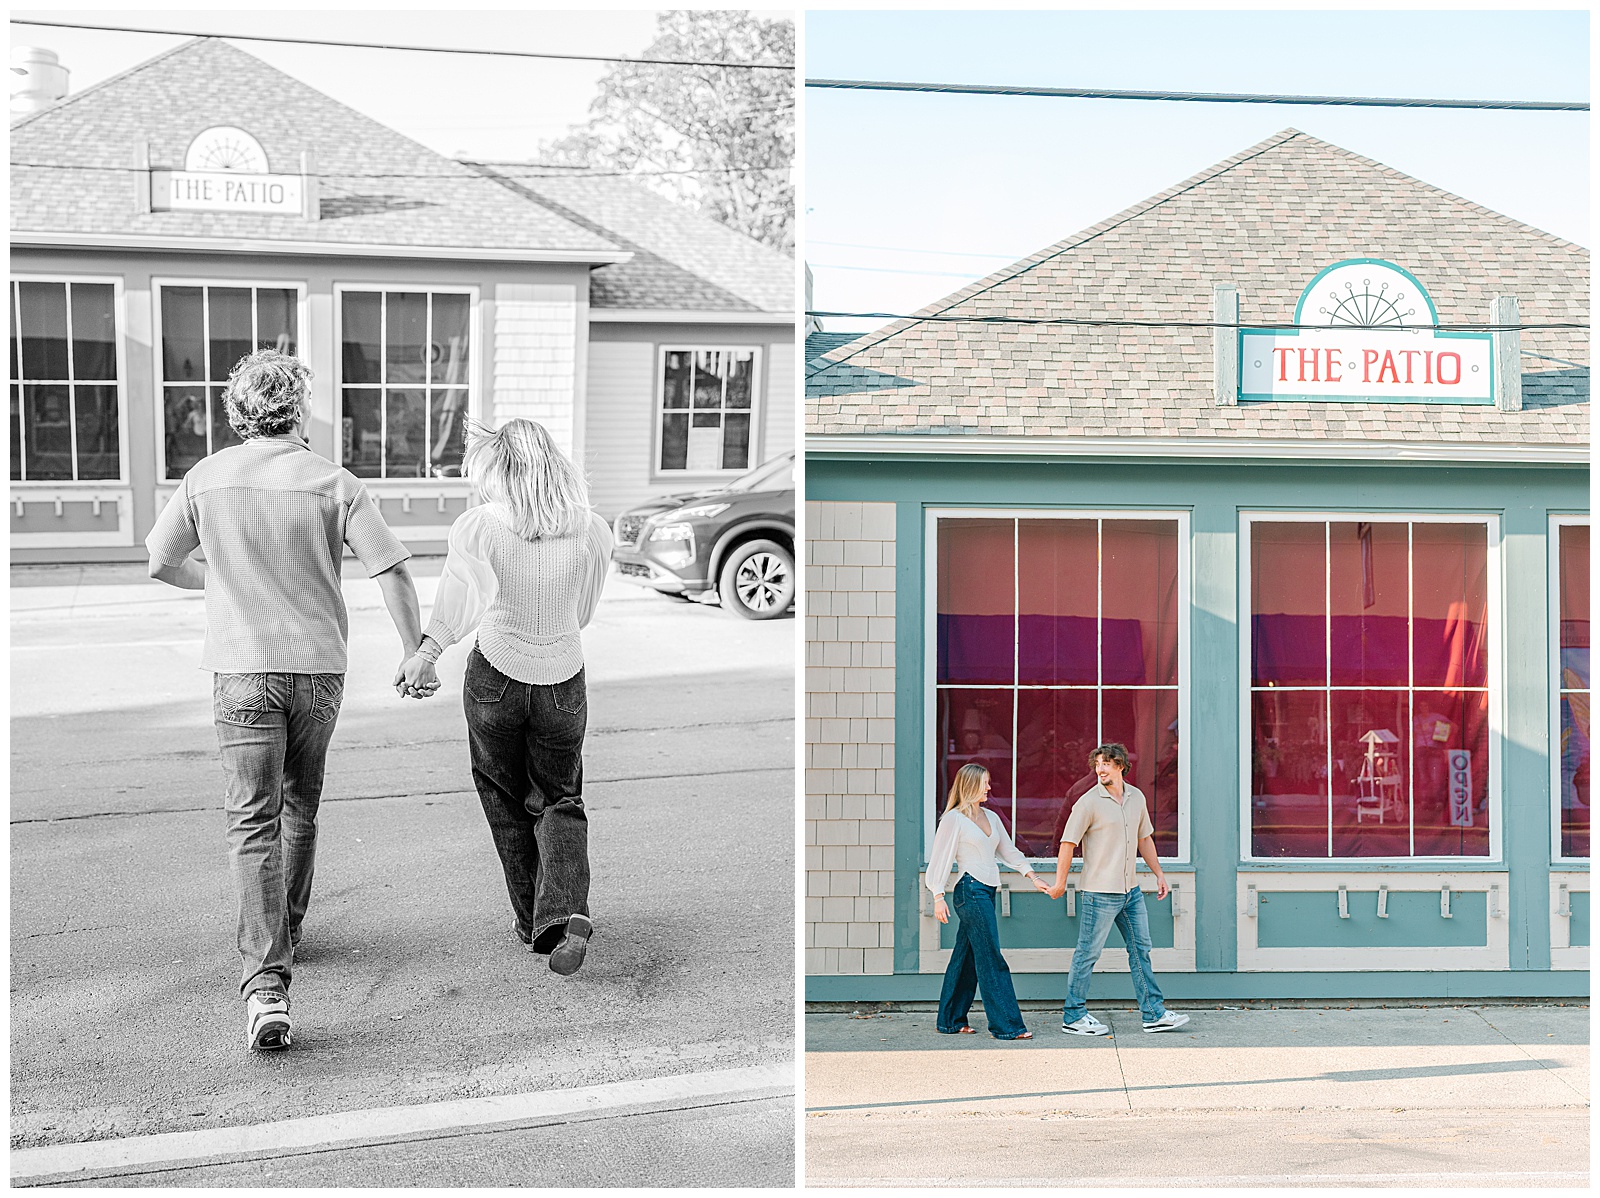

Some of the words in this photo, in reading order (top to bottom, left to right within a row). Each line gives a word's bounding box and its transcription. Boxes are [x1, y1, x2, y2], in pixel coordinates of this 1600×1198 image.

[170, 178, 213, 200] THE
[225, 181, 284, 204] PATIO
[1272, 347, 1343, 383] THE
[1362, 348, 1462, 385] PATIO
